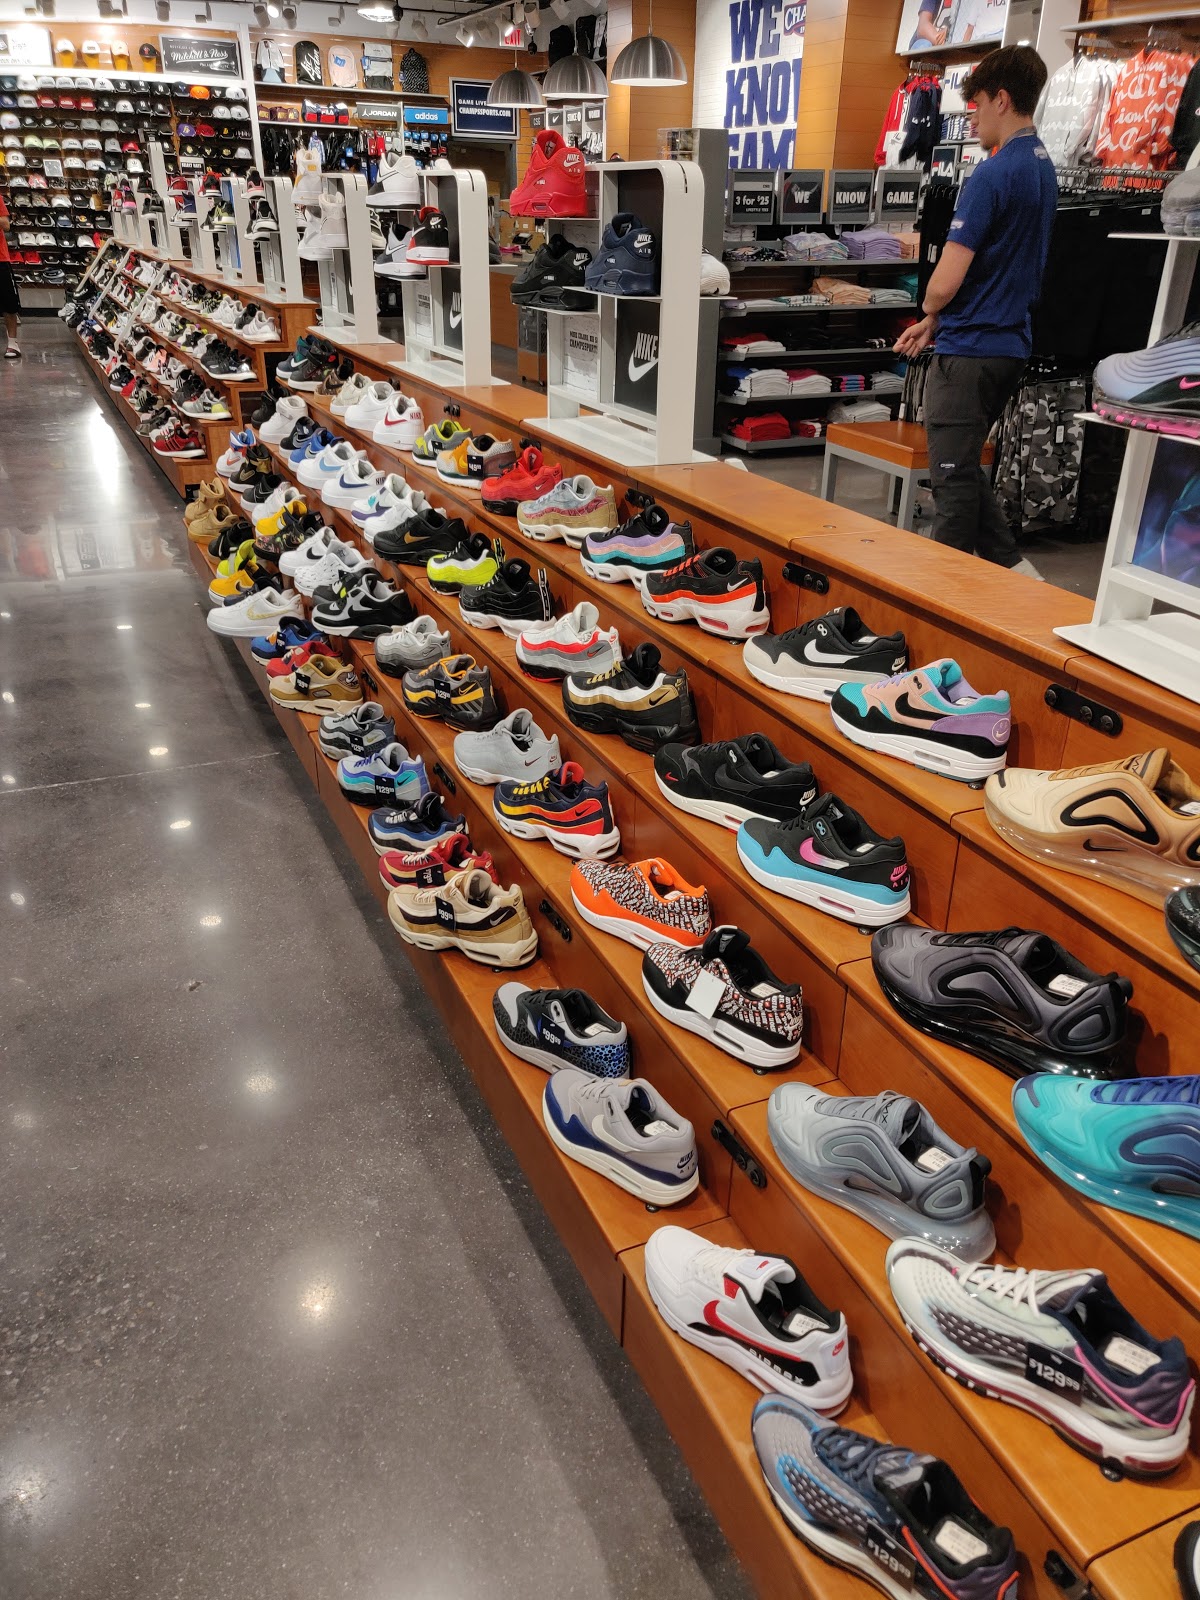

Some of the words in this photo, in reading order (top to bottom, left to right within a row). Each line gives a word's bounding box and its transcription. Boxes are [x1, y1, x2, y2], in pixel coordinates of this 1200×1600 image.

[729, 0, 783, 63] WE
[170, 49, 203, 61] Mitchell
[203, 51, 209, 59] &
[208, 48, 229, 58] Ness
[414, 113, 439, 121] adidas
[566, 153, 581, 162] NIKE
[931, 161, 954, 178] FILA
[735, 196, 741, 205] 3
[742, 195, 756, 206] for
[756, 195, 770, 206] $25
[794, 191, 810, 204] WE
[835, 191, 867, 204] KNOW
[886, 191, 914, 204] GAME
[636, 233, 652, 242] NIKE
[575, 252, 589, 261] NIKE
[634, 331, 659, 361] NIKE
